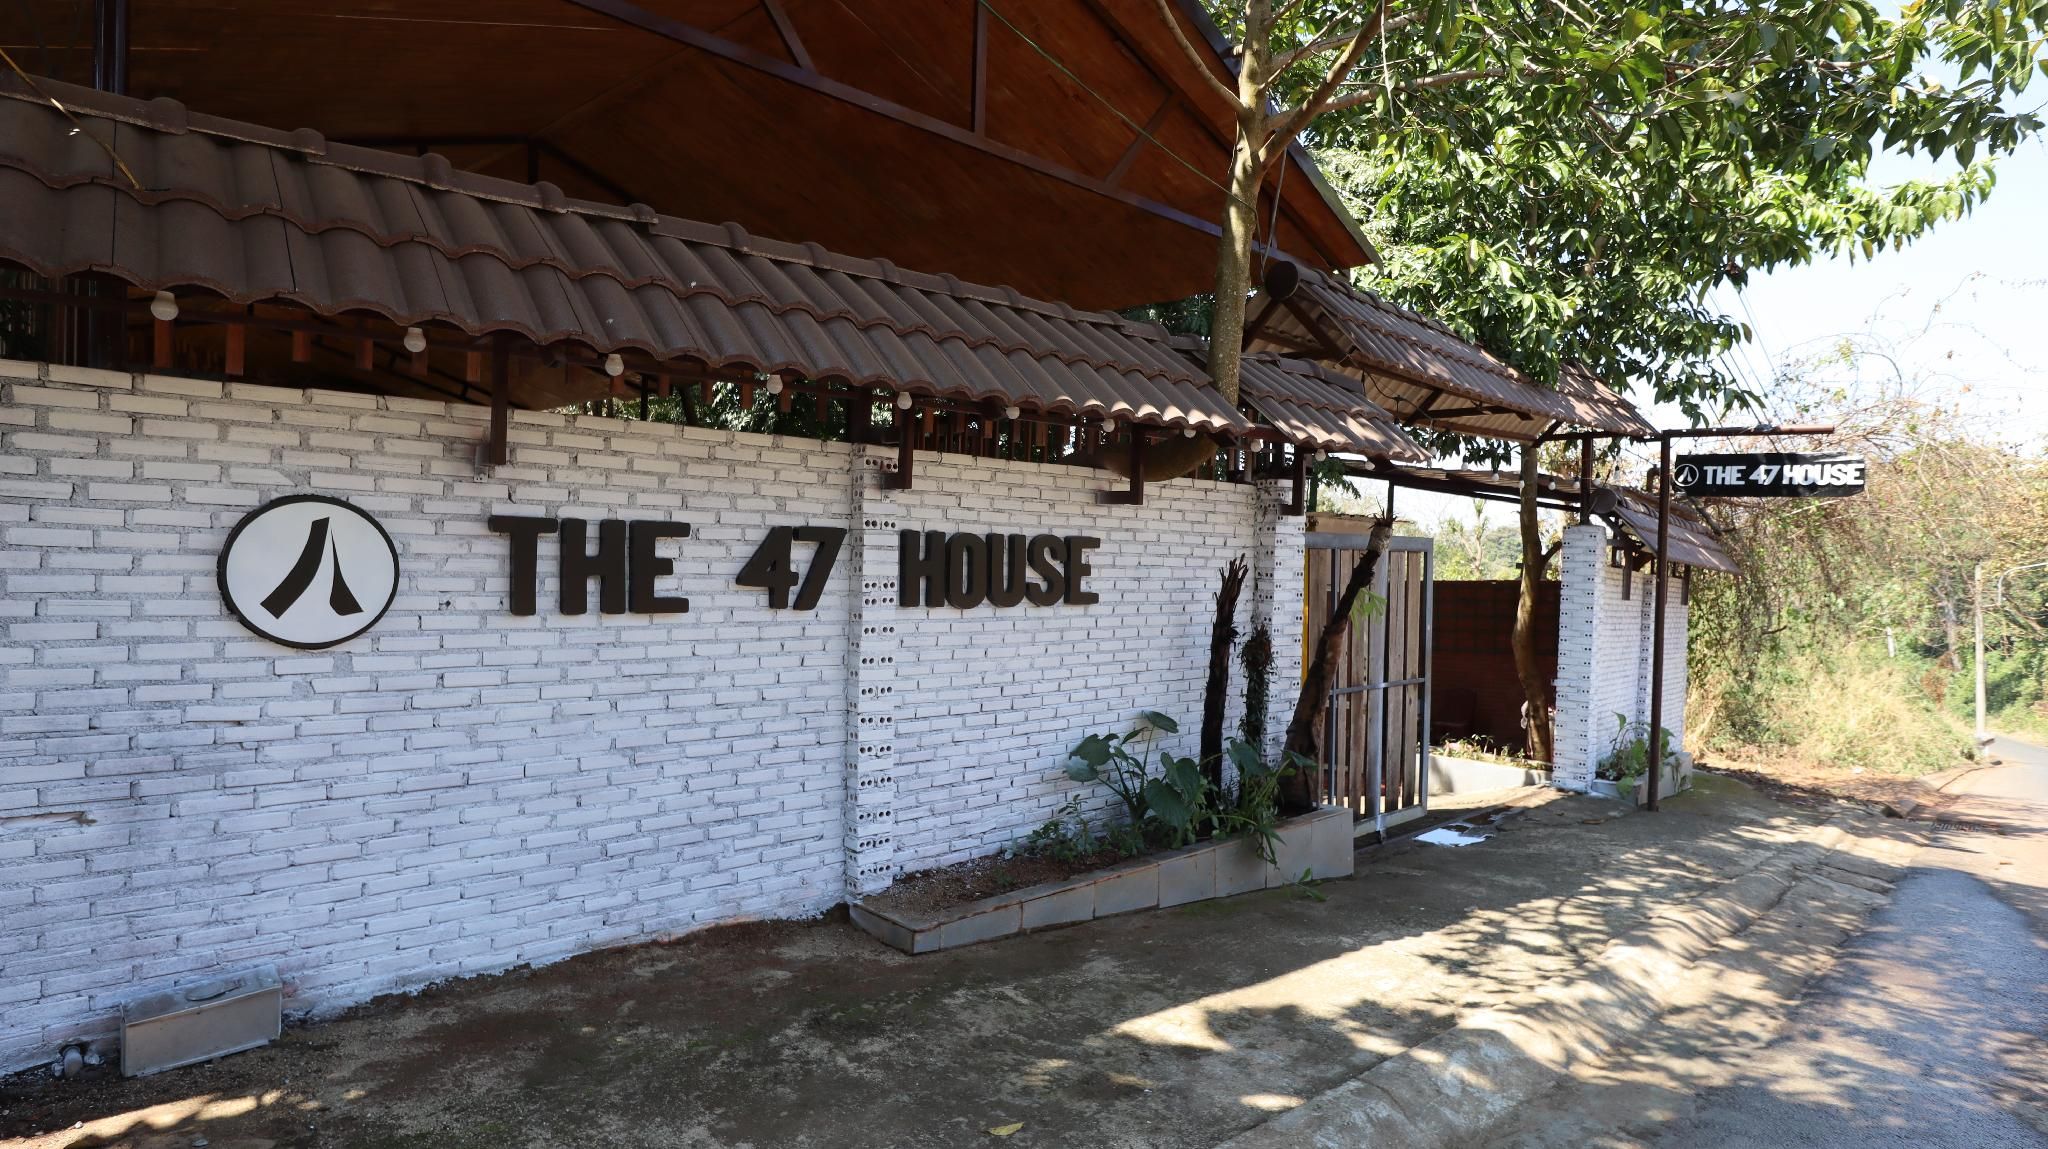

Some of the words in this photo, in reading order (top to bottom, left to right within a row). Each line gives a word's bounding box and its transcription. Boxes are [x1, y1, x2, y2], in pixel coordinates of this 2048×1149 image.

[1703, 465, 1746, 485] THE
[1748, 464, 1781, 485] 47
[1782, 464, 1864, 485] HOUSE
[487, 515, 691, 616] THE
[735, 525, 848, 611] 47
[899, 529, 1101, 610] HOUSE
